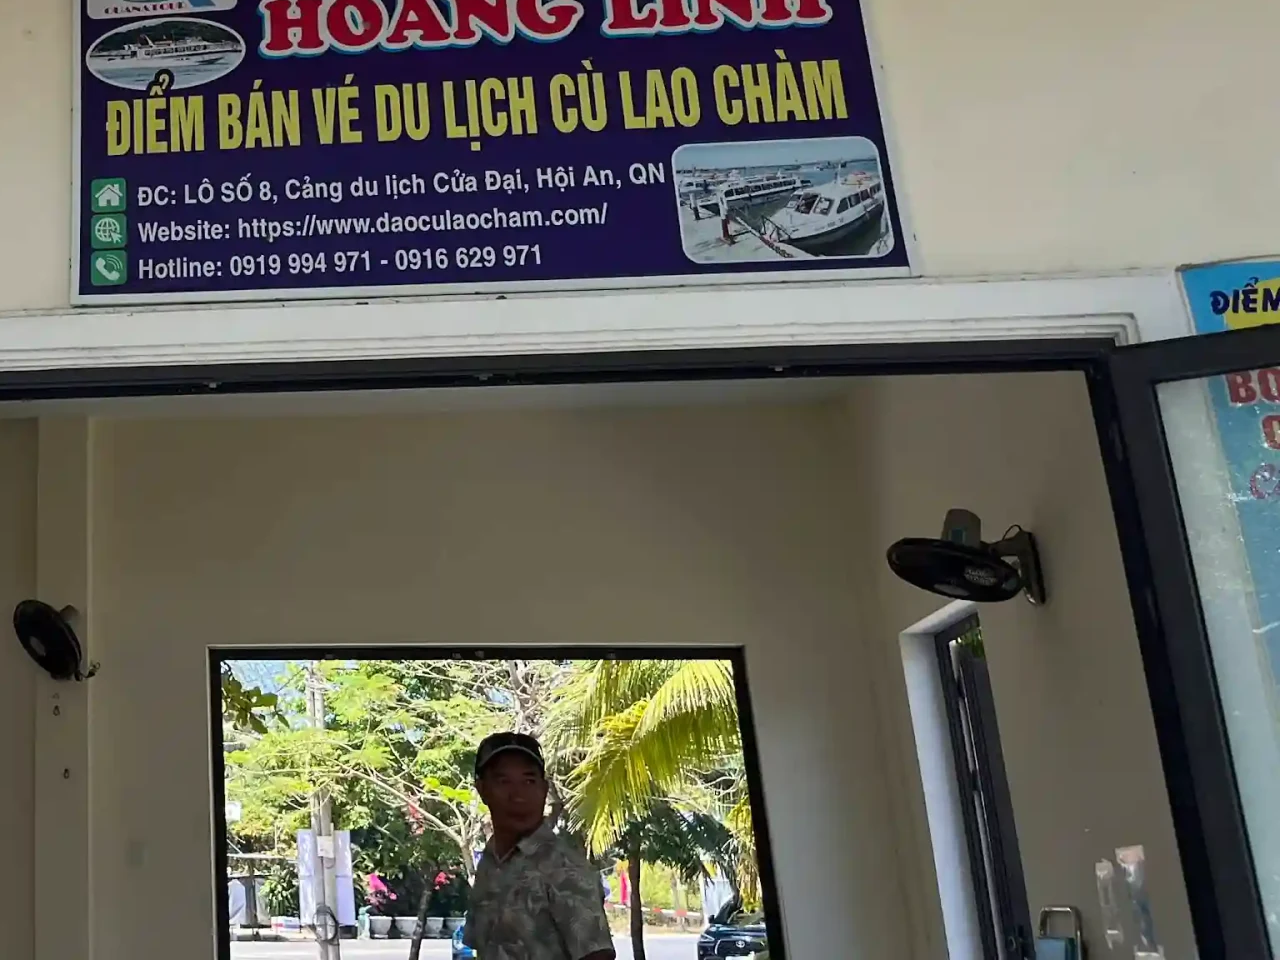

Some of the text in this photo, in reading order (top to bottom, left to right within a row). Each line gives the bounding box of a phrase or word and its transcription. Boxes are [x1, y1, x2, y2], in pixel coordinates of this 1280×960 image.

[106, 49, 849, 156] ĐIỂM BÁN VÉ DU LỊCH CÙ LAO CHÀM
[137, 162, 665, 207] ĐC: LÔ SỐ 8, Cảng du lịch Cửa Đại, Hội An, QN
[137, 202, 608, 243] Website: https://www.daoculaocham.com/
[138, 257, 222, 280] Hotline:
[230, 254, 282, 277] 0919
[288, 251, 328, 274] 994
[334, 250, 370, 272] 971
[395, 248, 449, 271] 0916
[455, 245, 496, 268] 629
[503, 244, 542, 266] 971
